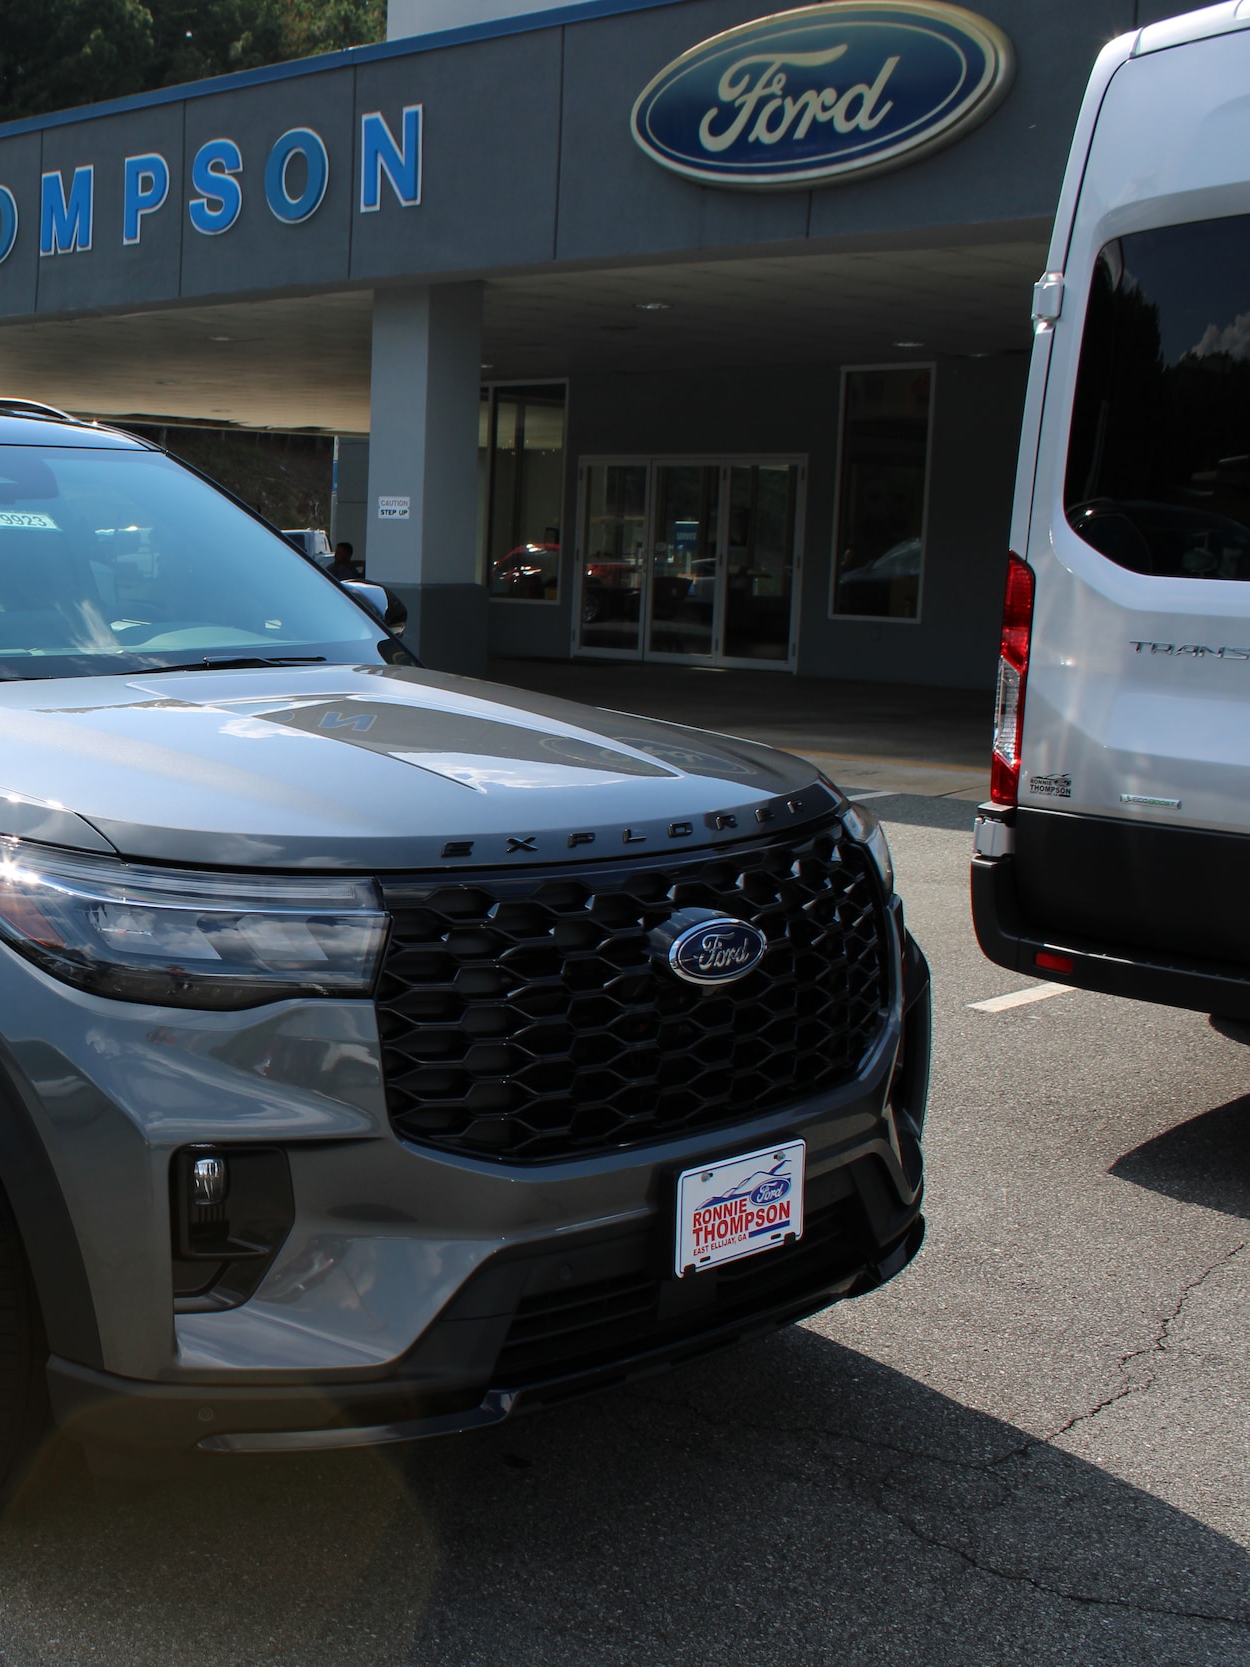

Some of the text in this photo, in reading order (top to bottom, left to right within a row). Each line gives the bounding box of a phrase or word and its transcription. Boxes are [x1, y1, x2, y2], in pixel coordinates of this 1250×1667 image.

[699, 44, 900, 153] Ford
[380, 499, 408, 507] CAUTION
[1030, 778, 1052, 786] RONNIE
[1030, 784, 1071, 795] THOMPSON
[440, 800, 804, 859] EXPLORER
[698, 931, 749, 971] Ford
[756, 1181, 784, 1203] Ford
[692, 1200, 791, 1247] THOMPSON
[693, 1198, 748, 1229] RONNIE
[693, 1245, 709, 1257] EAST
[737, 1233, 747, 1242] GA
